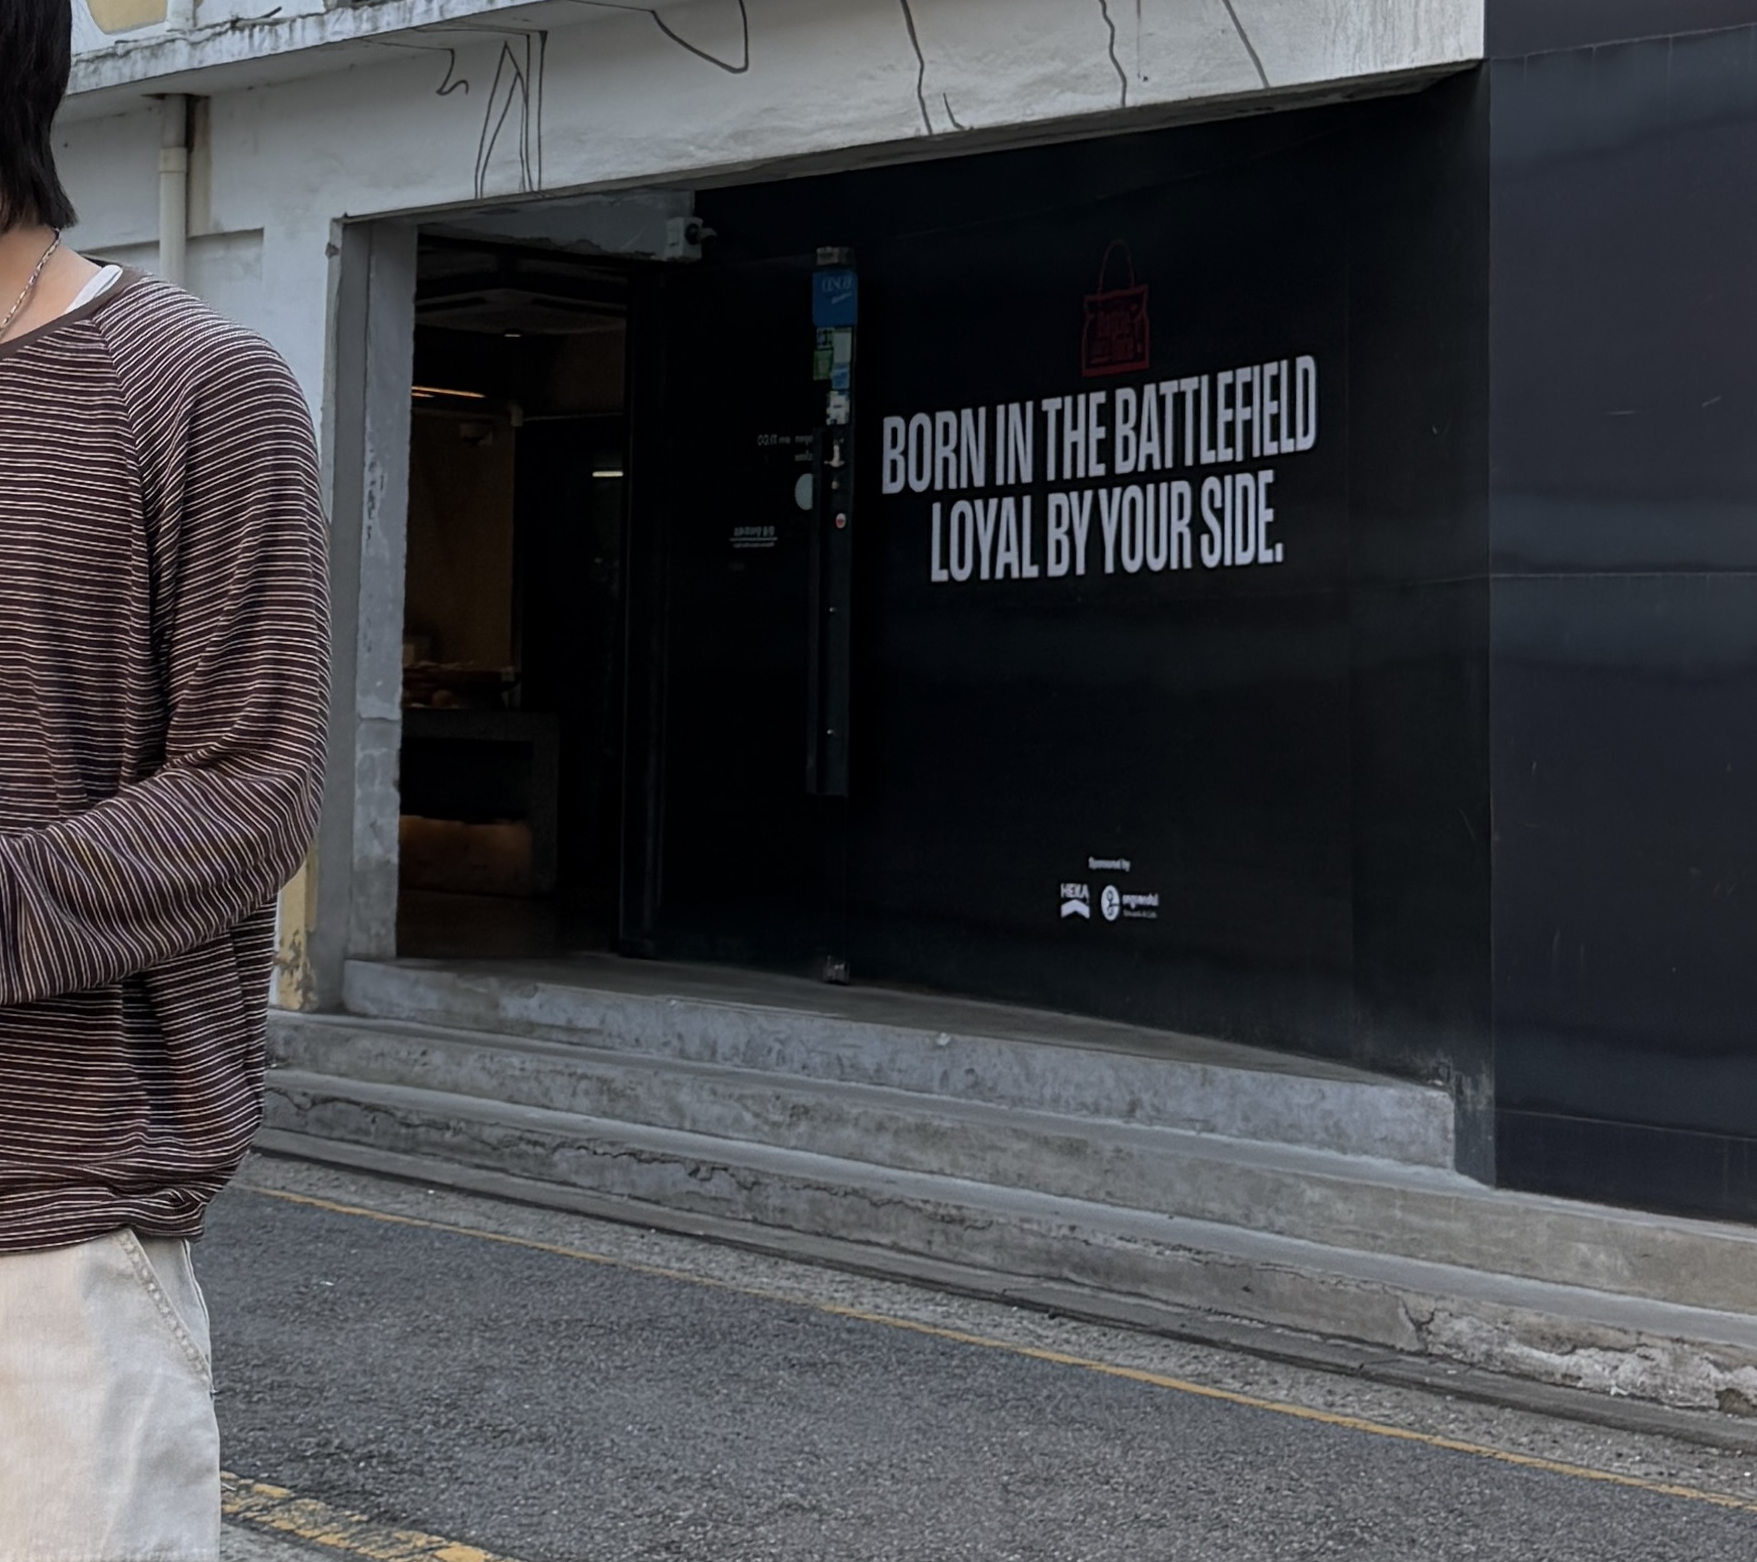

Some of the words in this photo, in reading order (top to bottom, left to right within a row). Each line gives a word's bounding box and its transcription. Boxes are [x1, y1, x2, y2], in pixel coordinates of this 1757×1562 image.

[882, 405, 987, 495] BORN
[995, 400, 1034, 486] IN
[1041, 390, 1107, 482] THE
[1114, 355, 1317, 475] BATTLEFIELD
[931, 494, 1039, 583] LOYAL
[1047, 489, 1092, 578] BY
[1098, 480, 1192, 574] YOUR
[1200, 469, 1283, 568] SIDE.
